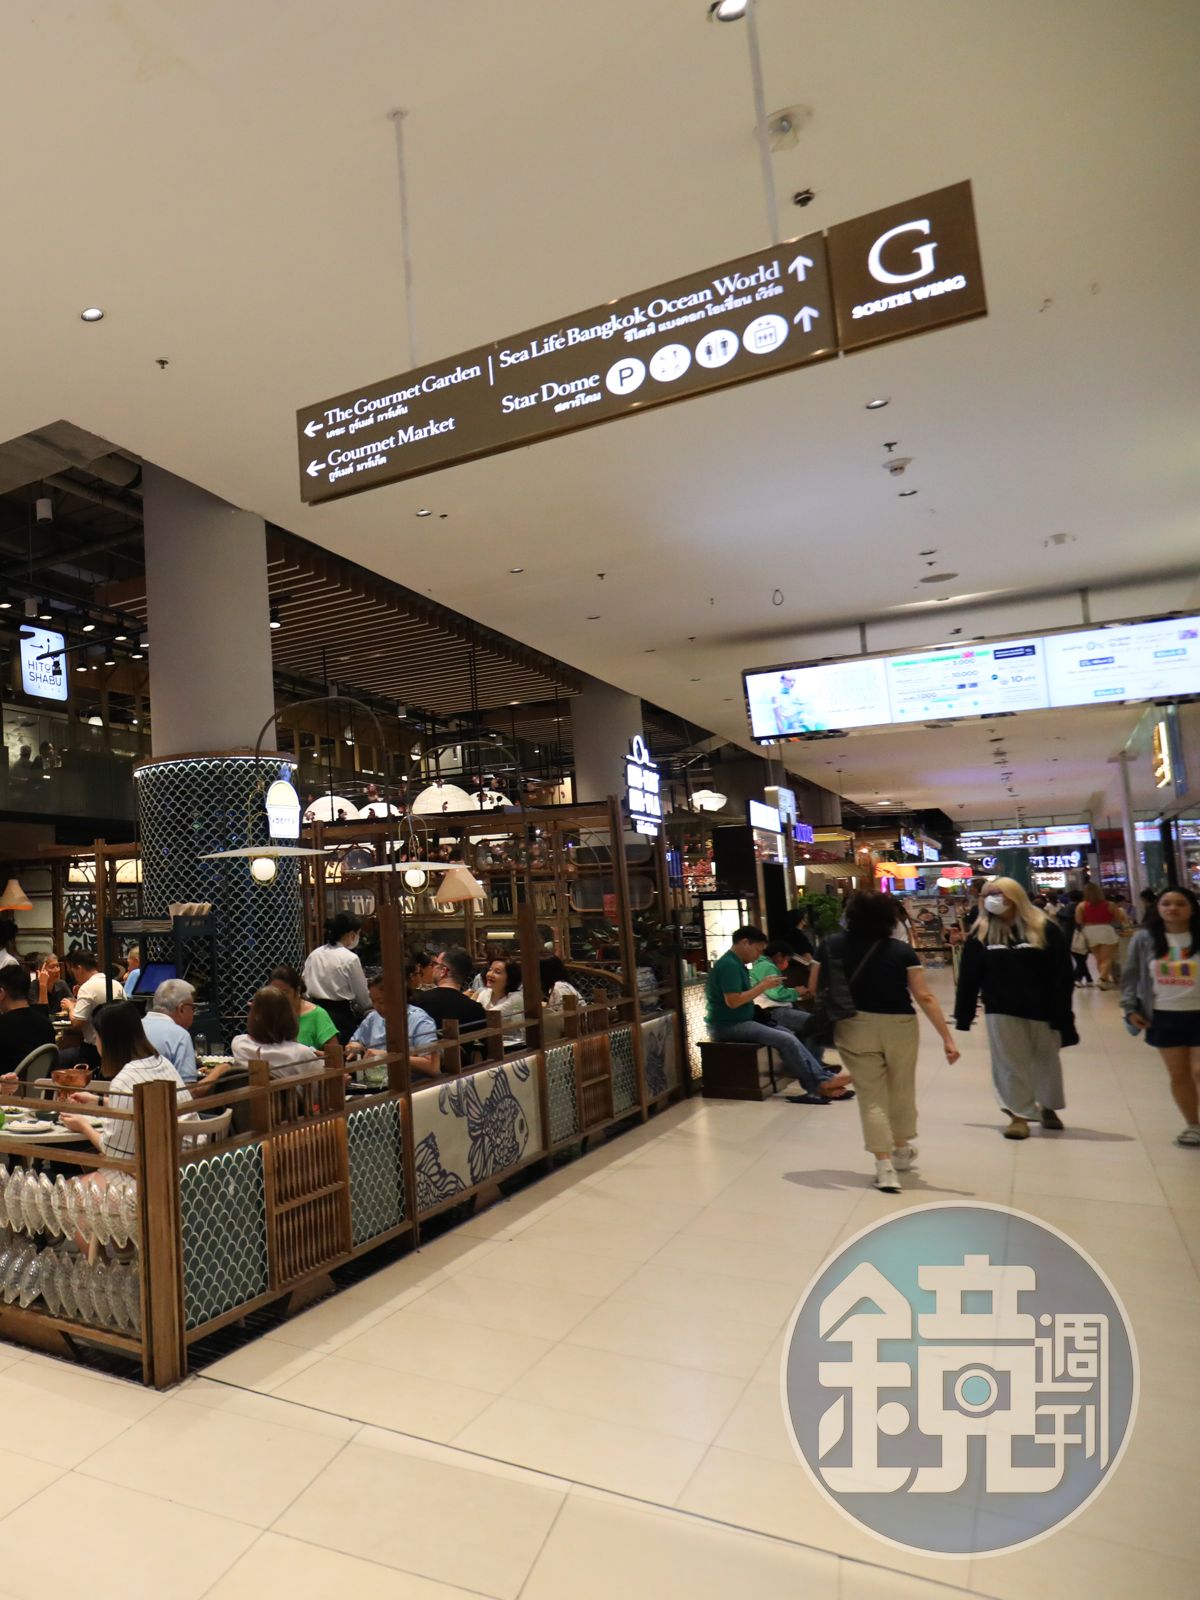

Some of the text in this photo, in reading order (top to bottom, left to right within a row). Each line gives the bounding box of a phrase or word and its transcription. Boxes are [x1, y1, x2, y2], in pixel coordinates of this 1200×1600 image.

[867, 218, 938, 284] G
[499, 261, 781, 368] Sea Life Bangkok Ocean World
[851, 274, 967, 319] SOUTH WING
[324, 365, 482, 426] The Gourmet Garden
[501, 374, 601, 414] Star Dome
[618, 366, 634, 387] P
[327, 417, 456, 466] Gourmet Market
[29, 671, 62, 687] SHABU
